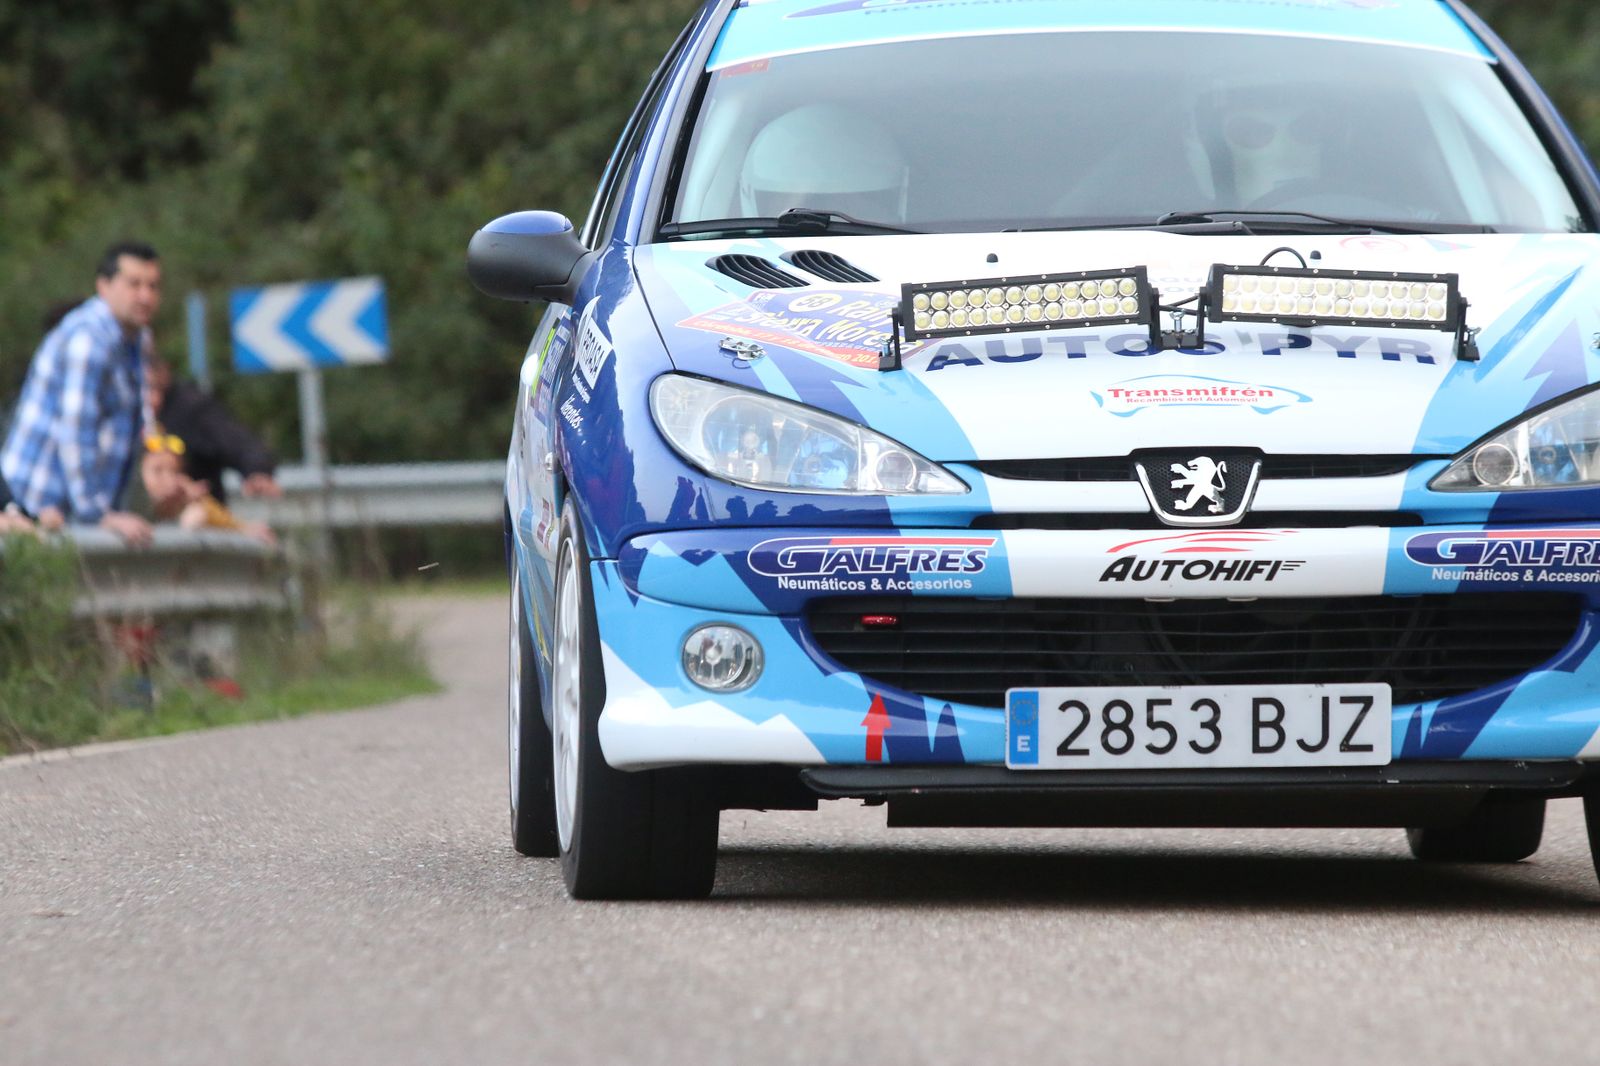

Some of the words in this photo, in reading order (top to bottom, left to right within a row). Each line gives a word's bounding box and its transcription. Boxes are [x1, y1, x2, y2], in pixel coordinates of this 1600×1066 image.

[1258, 333, 1435, 364] PYR
[1107, 386, 1274, 398] Transmifrén
[747, 536, 997, 576] GALFRES
[1099, 555, 1286, 581] AUTOHIFI
[1432, 568, 1519, 581] Neumáticos
[1523, 569, 1534, 581] &
[778, 576, 866, 590] Neumáticos
[870, 578, 882, 590] &
[885, 577, 972, 590] Accesorios
[1056, 698, 1223, 756] 2853
[1251, 695, 1375, 754] BJZ
[1016, 735, 1031, 752] E
